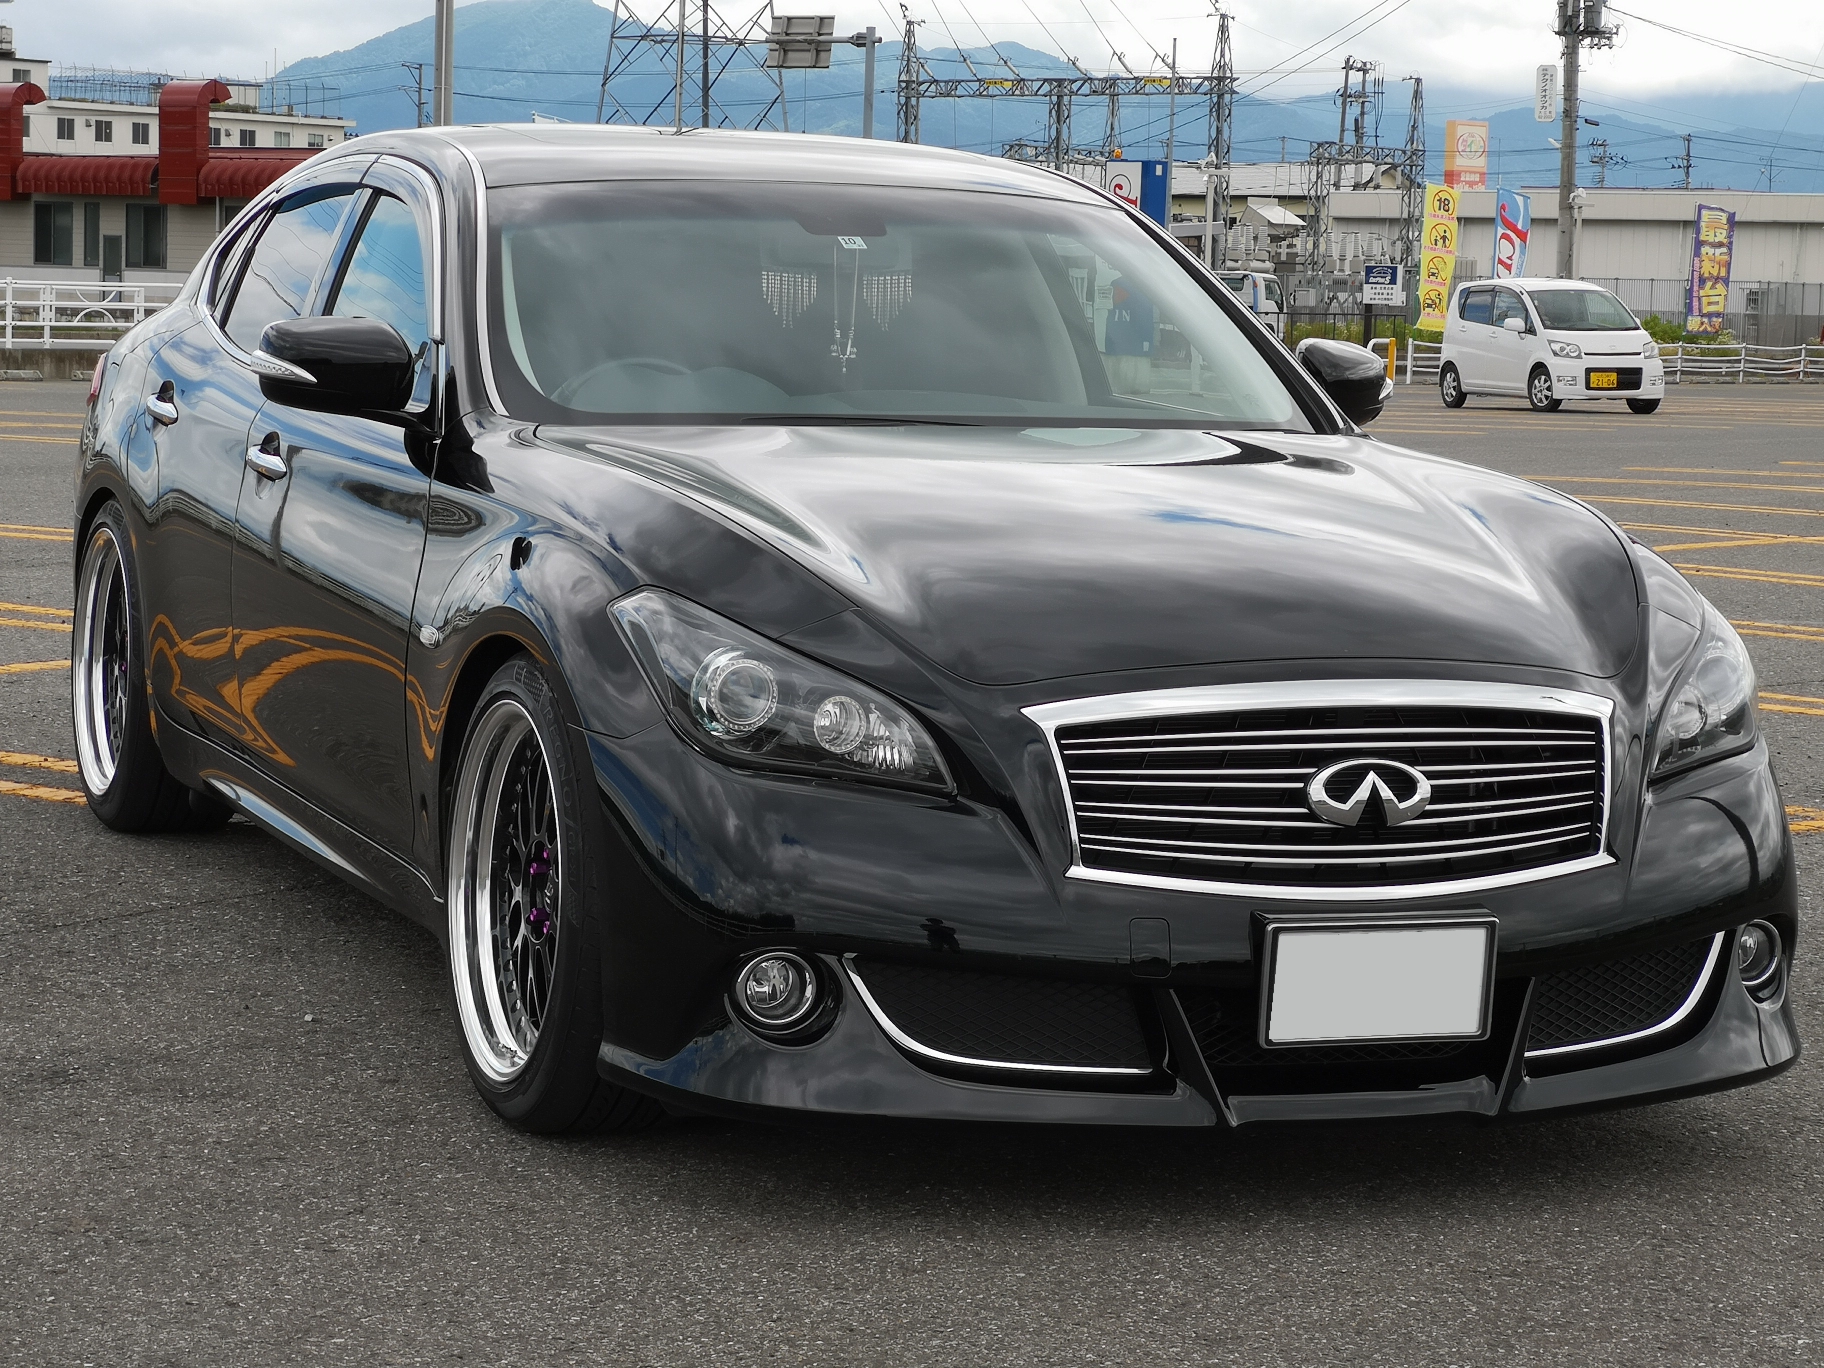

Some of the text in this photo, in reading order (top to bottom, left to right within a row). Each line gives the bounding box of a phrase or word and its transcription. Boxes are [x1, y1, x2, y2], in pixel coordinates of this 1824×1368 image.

[1436, 197, 1450, 213] 18
[841, 237, 856, 245] 10
[1700, 209, 1729, 314] 最新台
[1114, 309, 1131, 322] IN
[542, 705, 573, 808] REGNO
